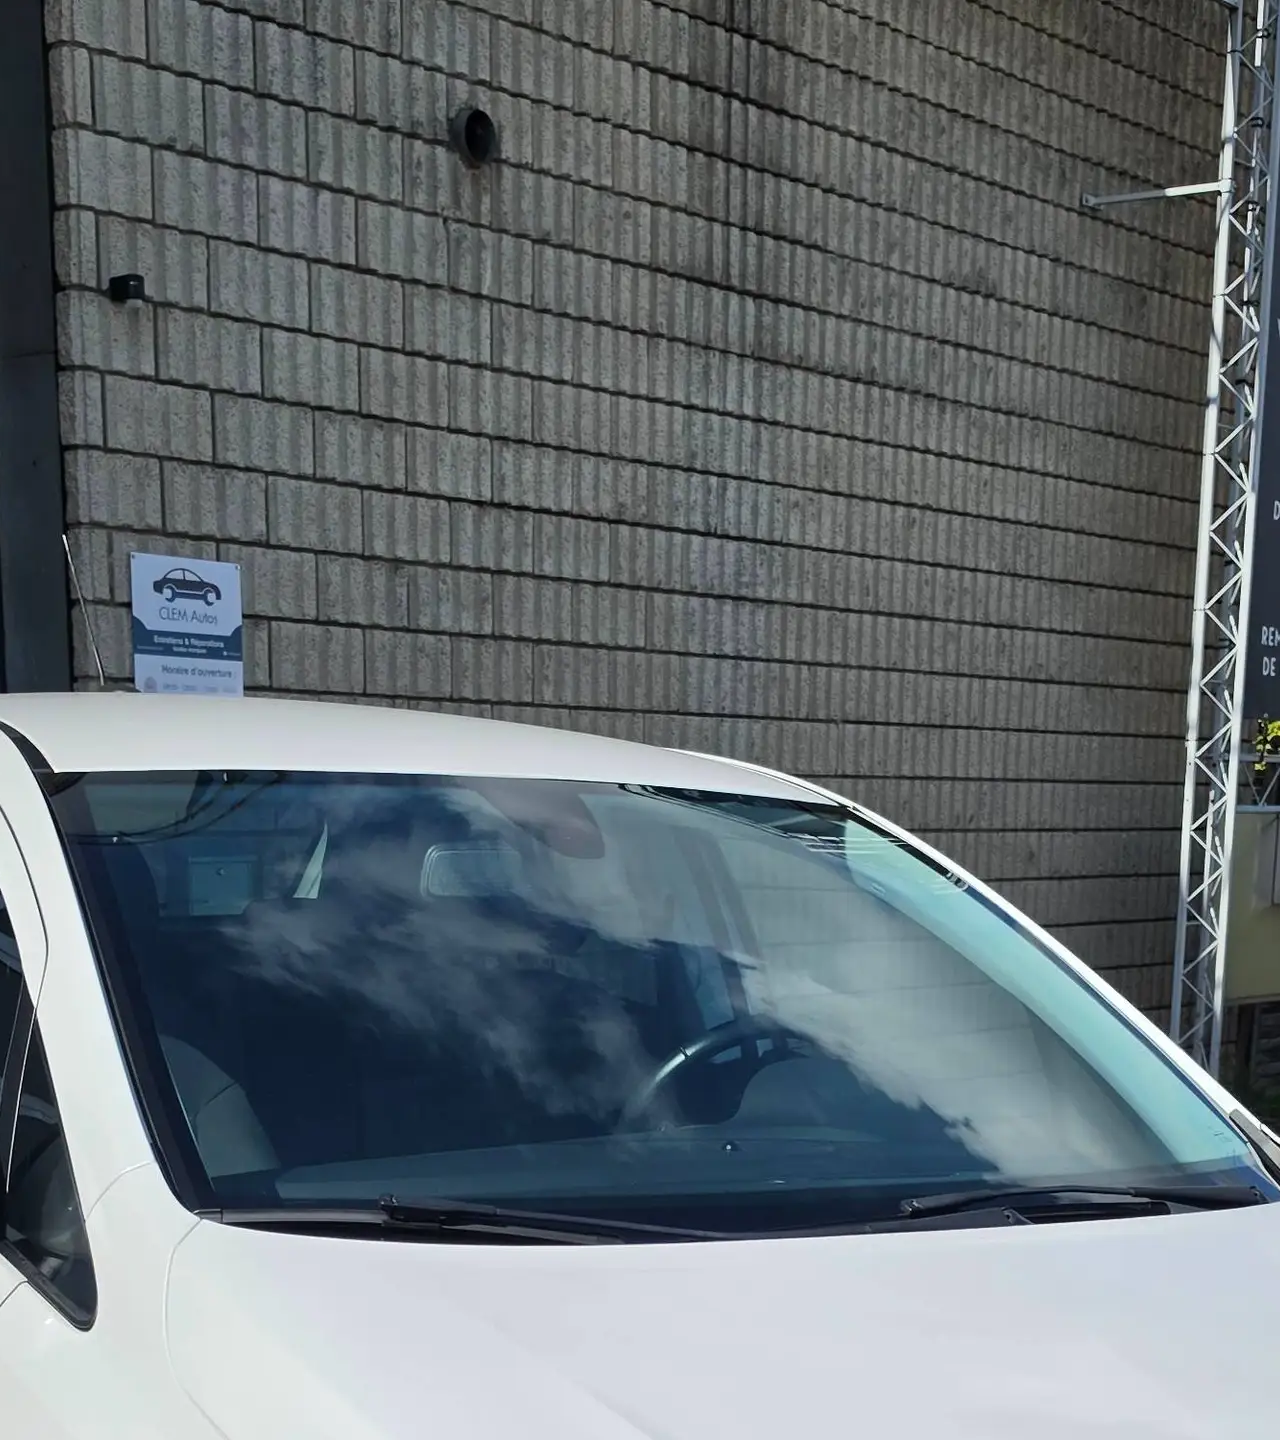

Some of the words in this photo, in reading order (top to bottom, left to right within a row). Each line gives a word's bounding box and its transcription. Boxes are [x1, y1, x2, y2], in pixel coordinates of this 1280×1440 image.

[159, 606, 187, 621] CLEM
[191, 610, 218, 626] Autos
[1263, 656, 1276, 677] DE
